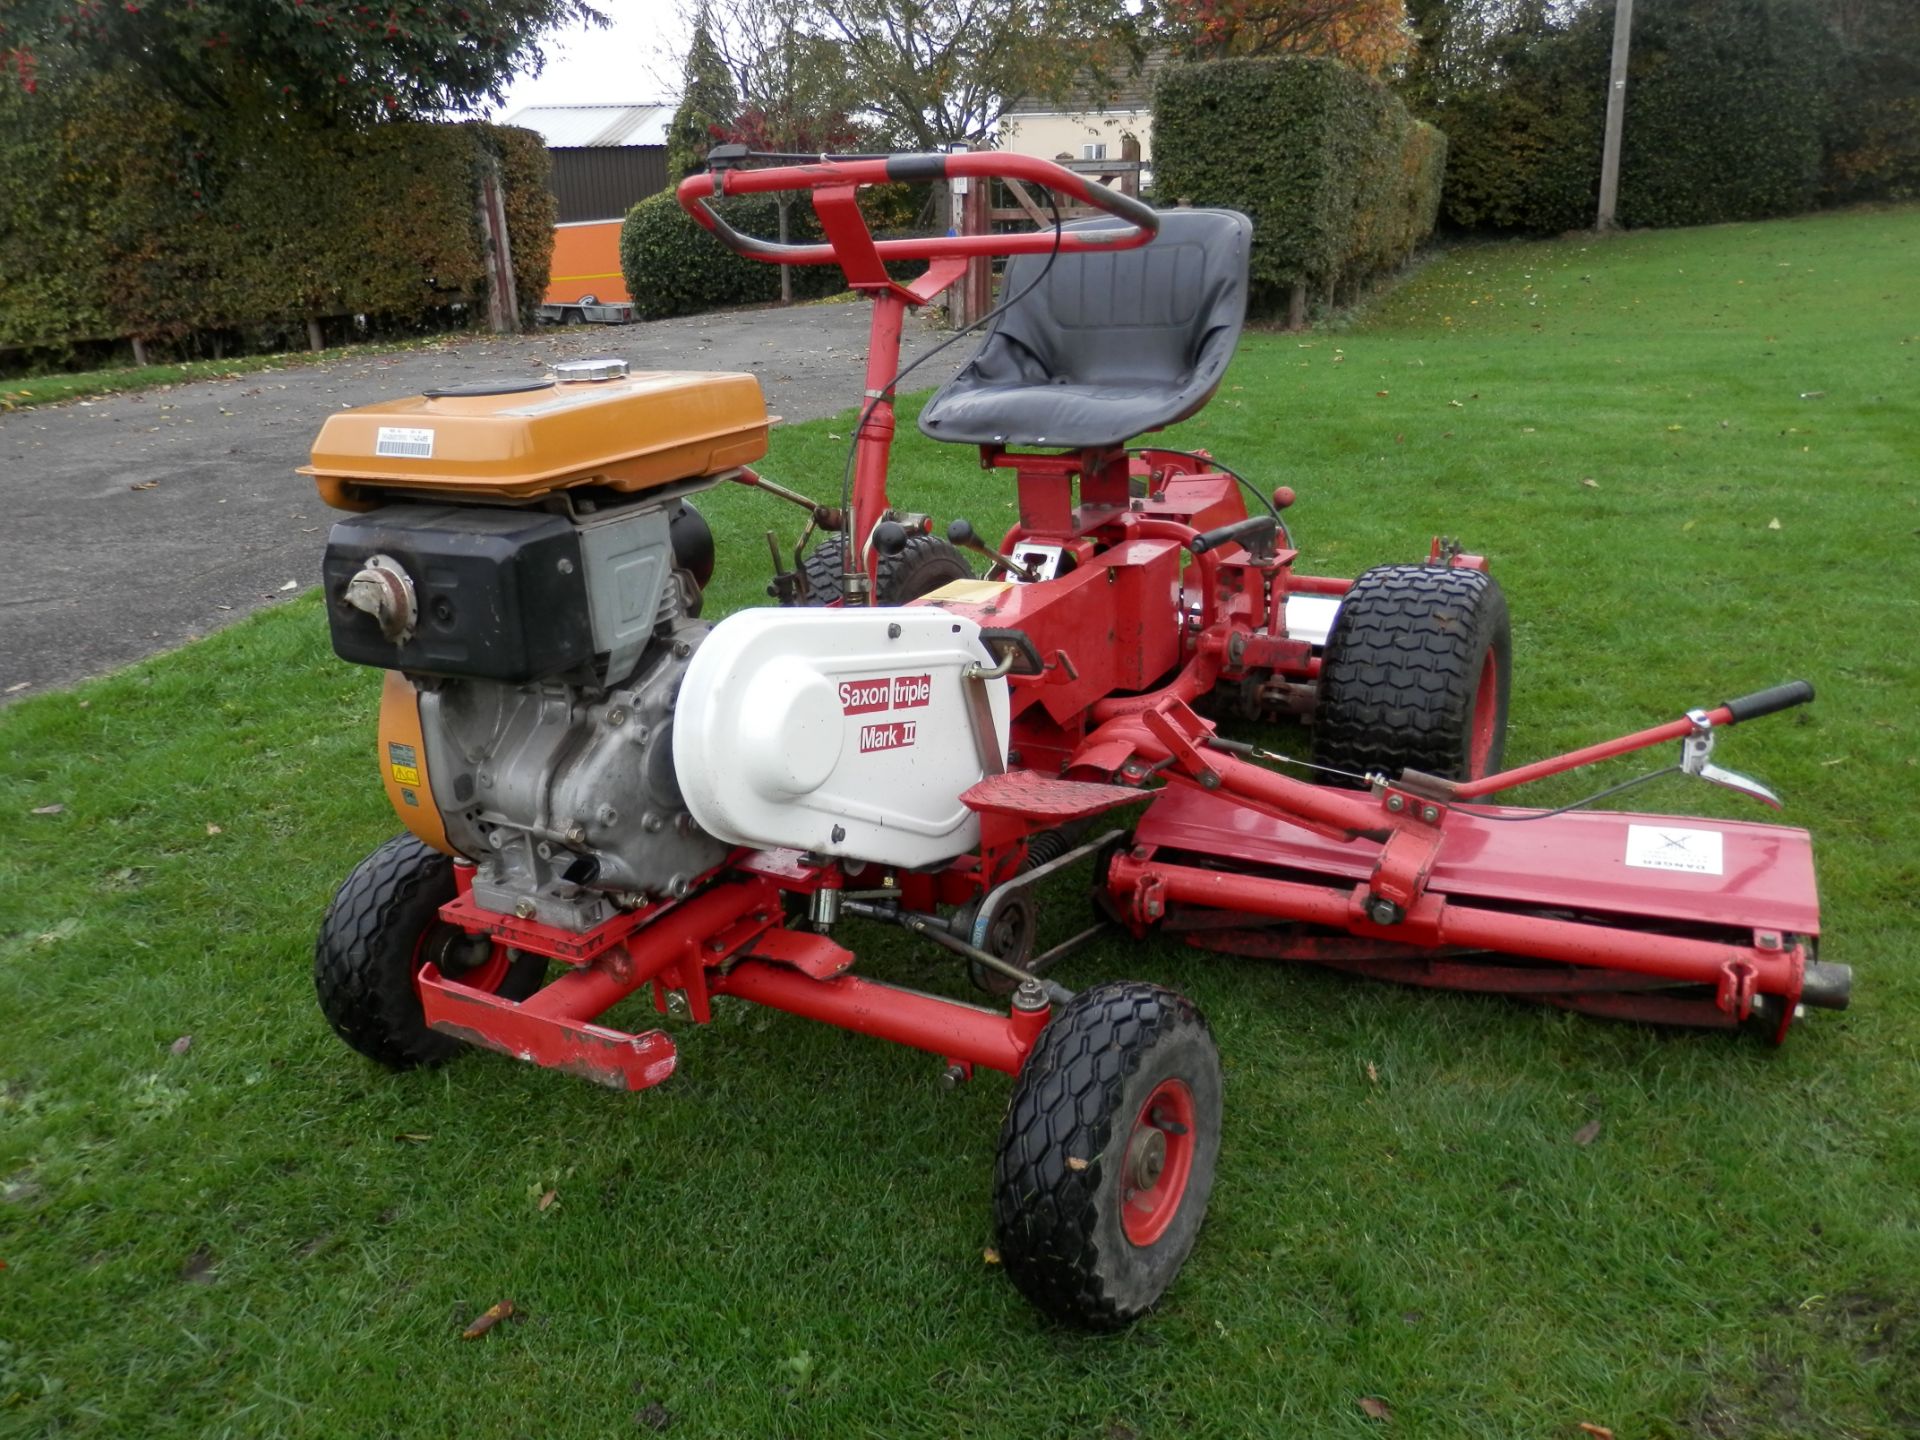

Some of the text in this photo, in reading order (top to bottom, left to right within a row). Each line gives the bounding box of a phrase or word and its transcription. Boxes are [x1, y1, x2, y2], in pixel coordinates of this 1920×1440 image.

[840, 679, 929, 708] Saxon triple
[862, 722, 916, 750] Mark II
